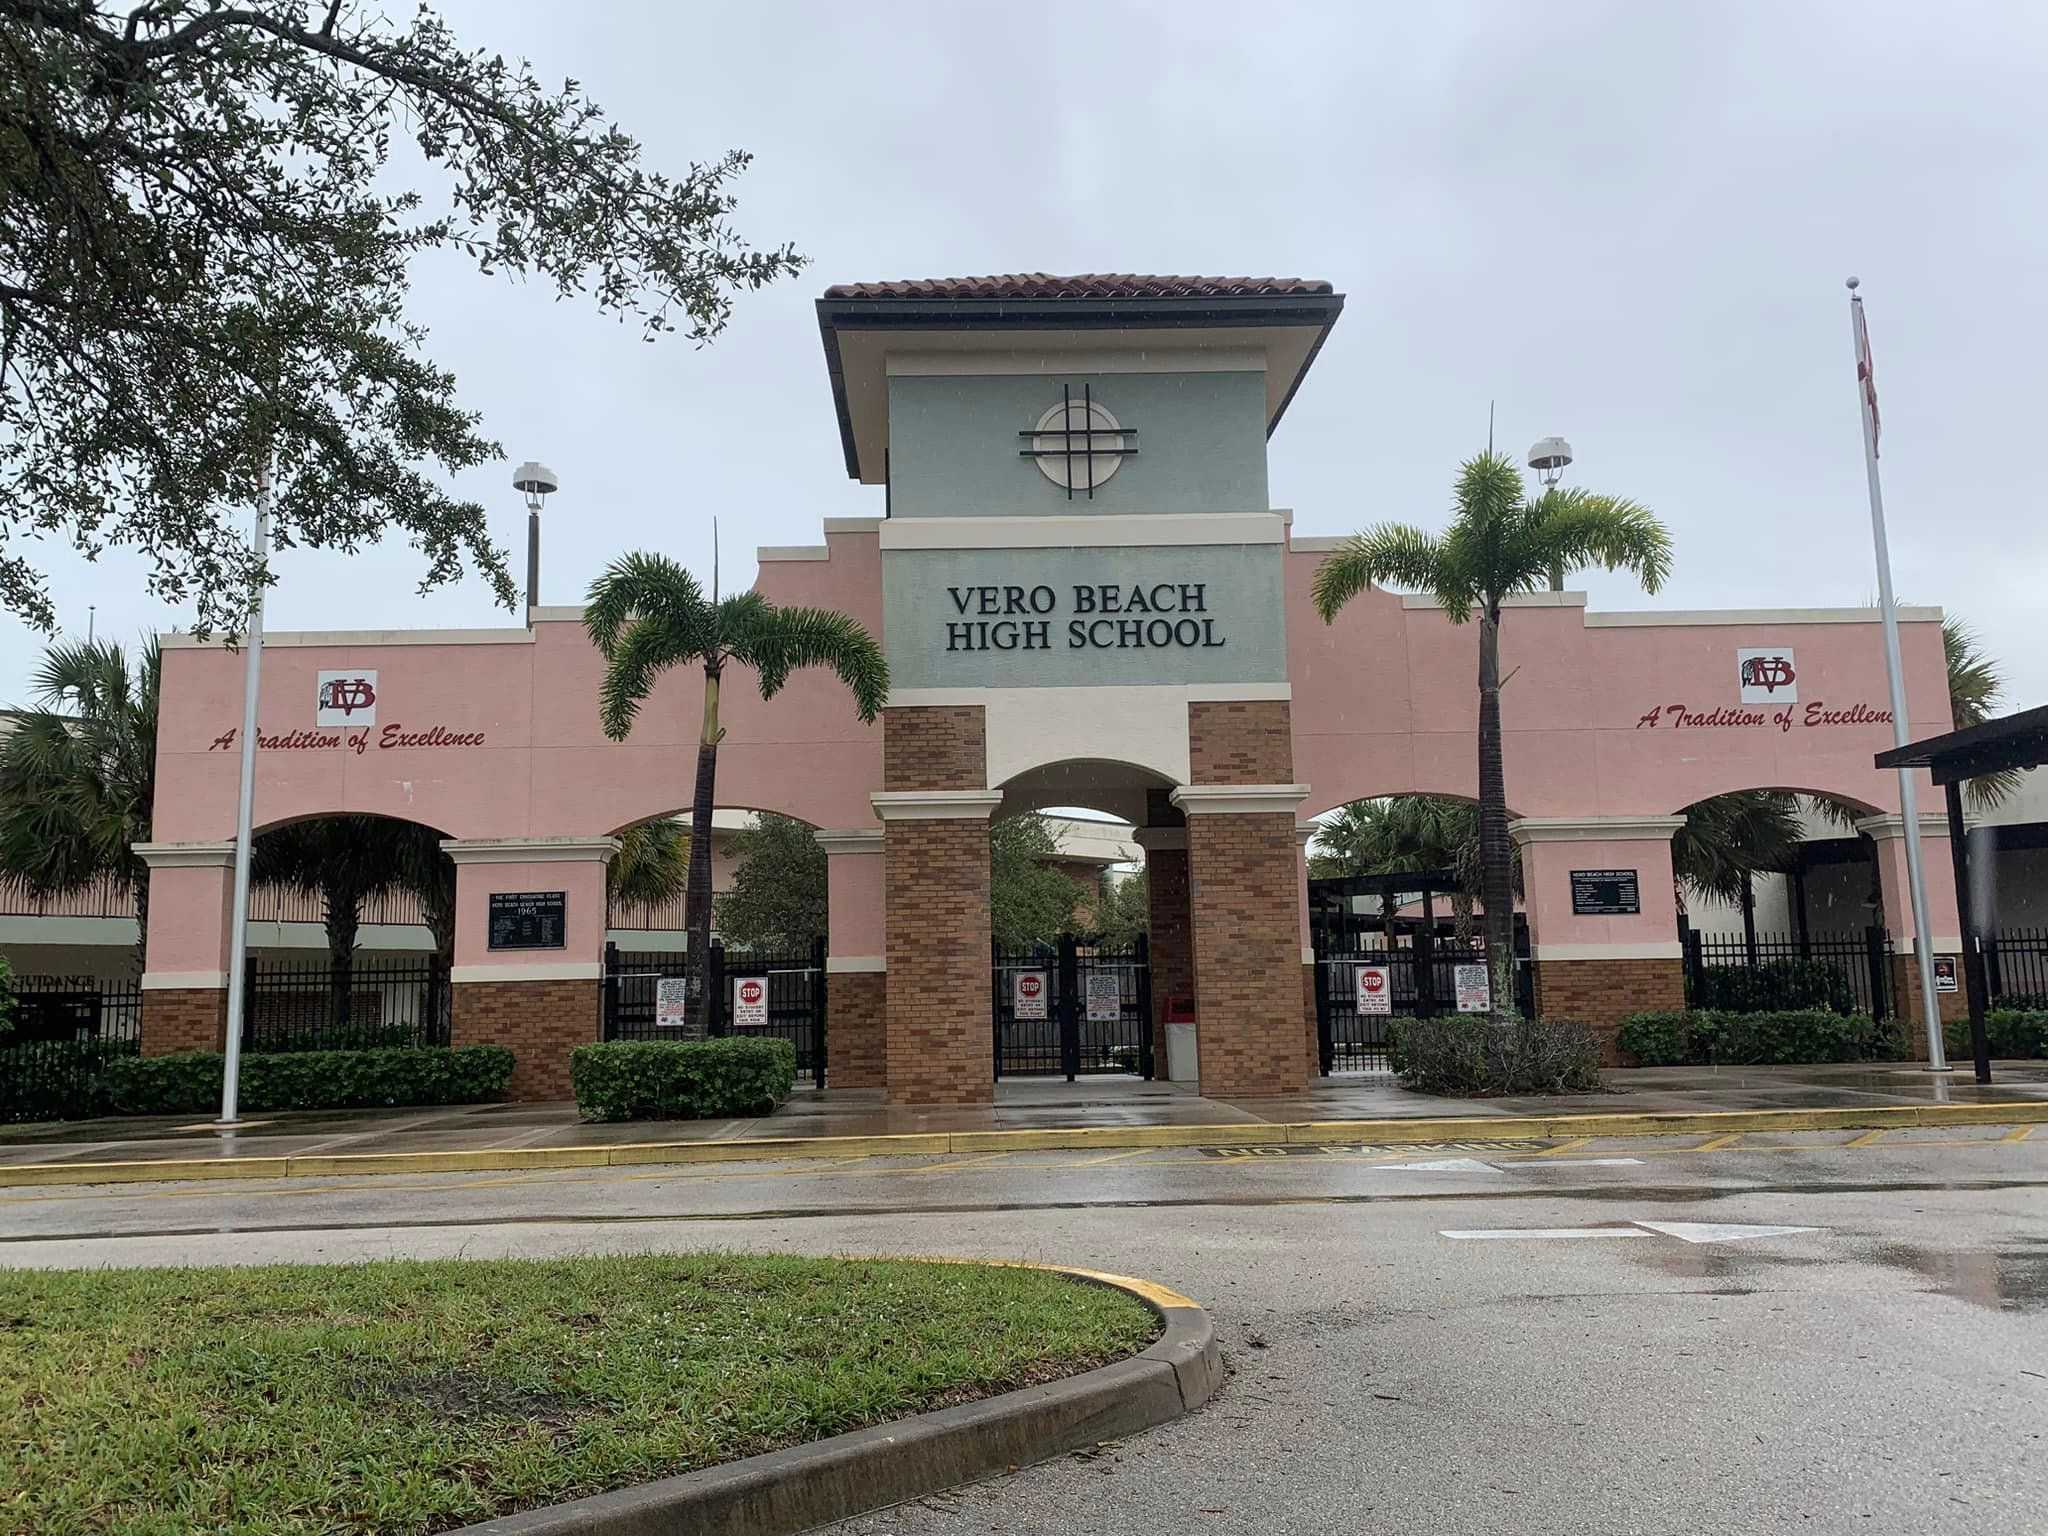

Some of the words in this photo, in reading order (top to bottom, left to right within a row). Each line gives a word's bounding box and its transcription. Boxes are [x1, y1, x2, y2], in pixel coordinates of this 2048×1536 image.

[946, 585, 1056, 615] VERO
[1072, 583, 1208, 614] BEACH
[945, 620, 1052, 651] HIGH
[1068, 618, 1226, 649] SCHOOL
[1637, 705, 1661, 729] A
[1666, 703, 1765, 728] Tradition
[1773, 704, 1794, 733] of
[1803, 701, 1894, 728] Excellenc
[208, 727, 237, 751] A
[348, 726, 370, 755] of
[378, 723, 485, 750] Excellence
[517, 906, 537, 916] 1965
[1021, 981, 1040, 992] STOP
[1363, 976, 1382, 987] STOP
[741, 987, 760, 998] STOP
[1215, 1146, 1289, 1157] NO
